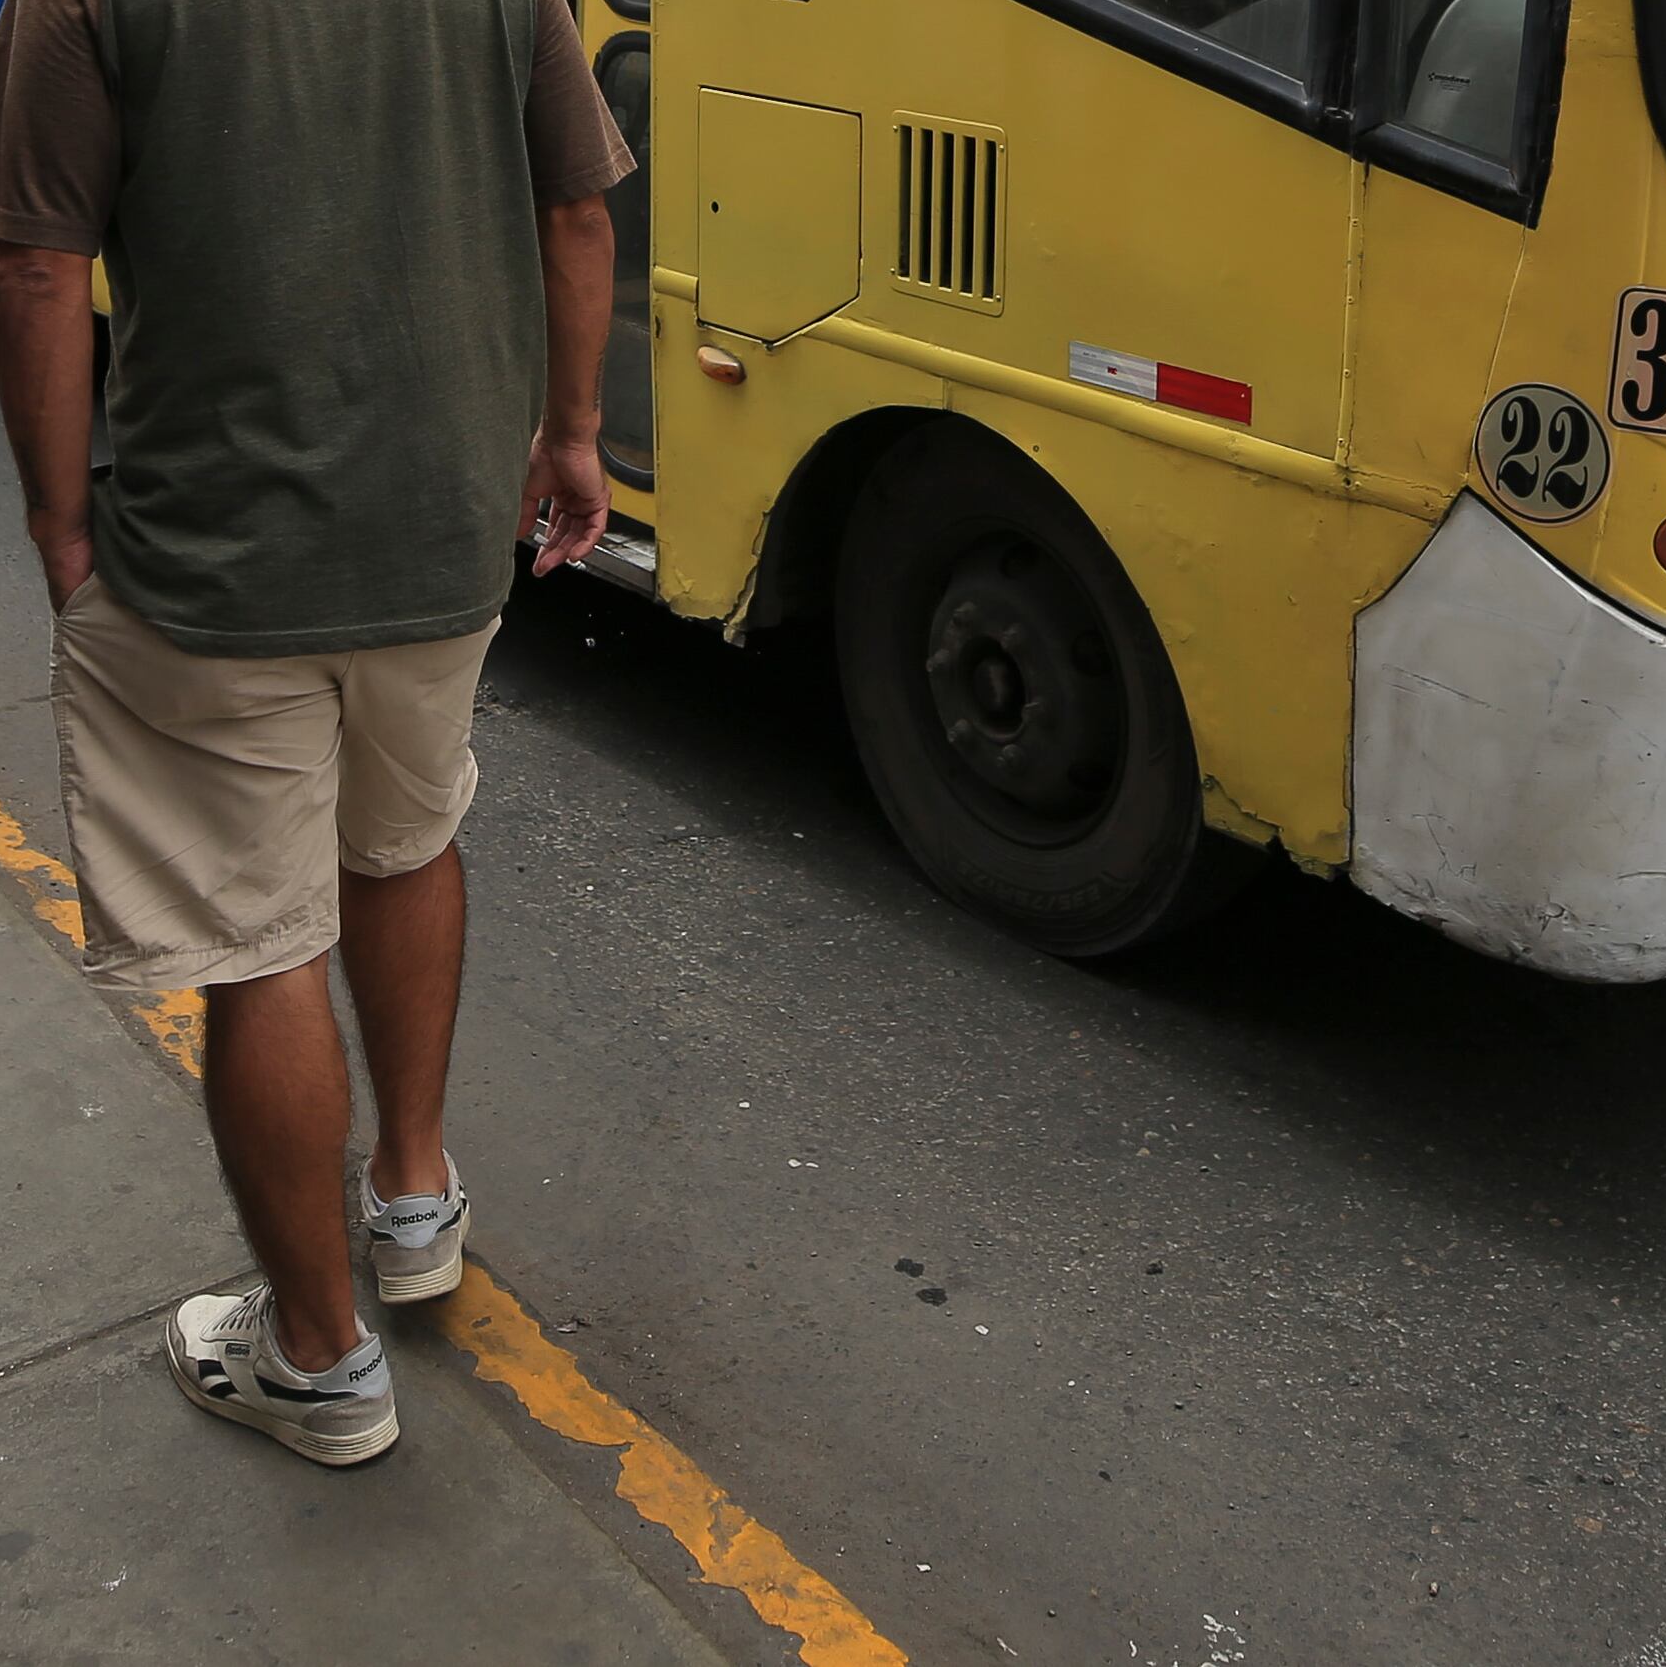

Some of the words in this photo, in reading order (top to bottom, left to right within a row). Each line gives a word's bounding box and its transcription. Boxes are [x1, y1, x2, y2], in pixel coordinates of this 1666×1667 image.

[1496, 394, 1601, 510] 22
[391, 1210, 438, 1227] Reebok
[348, 1351, 383, 1383] Reebo
